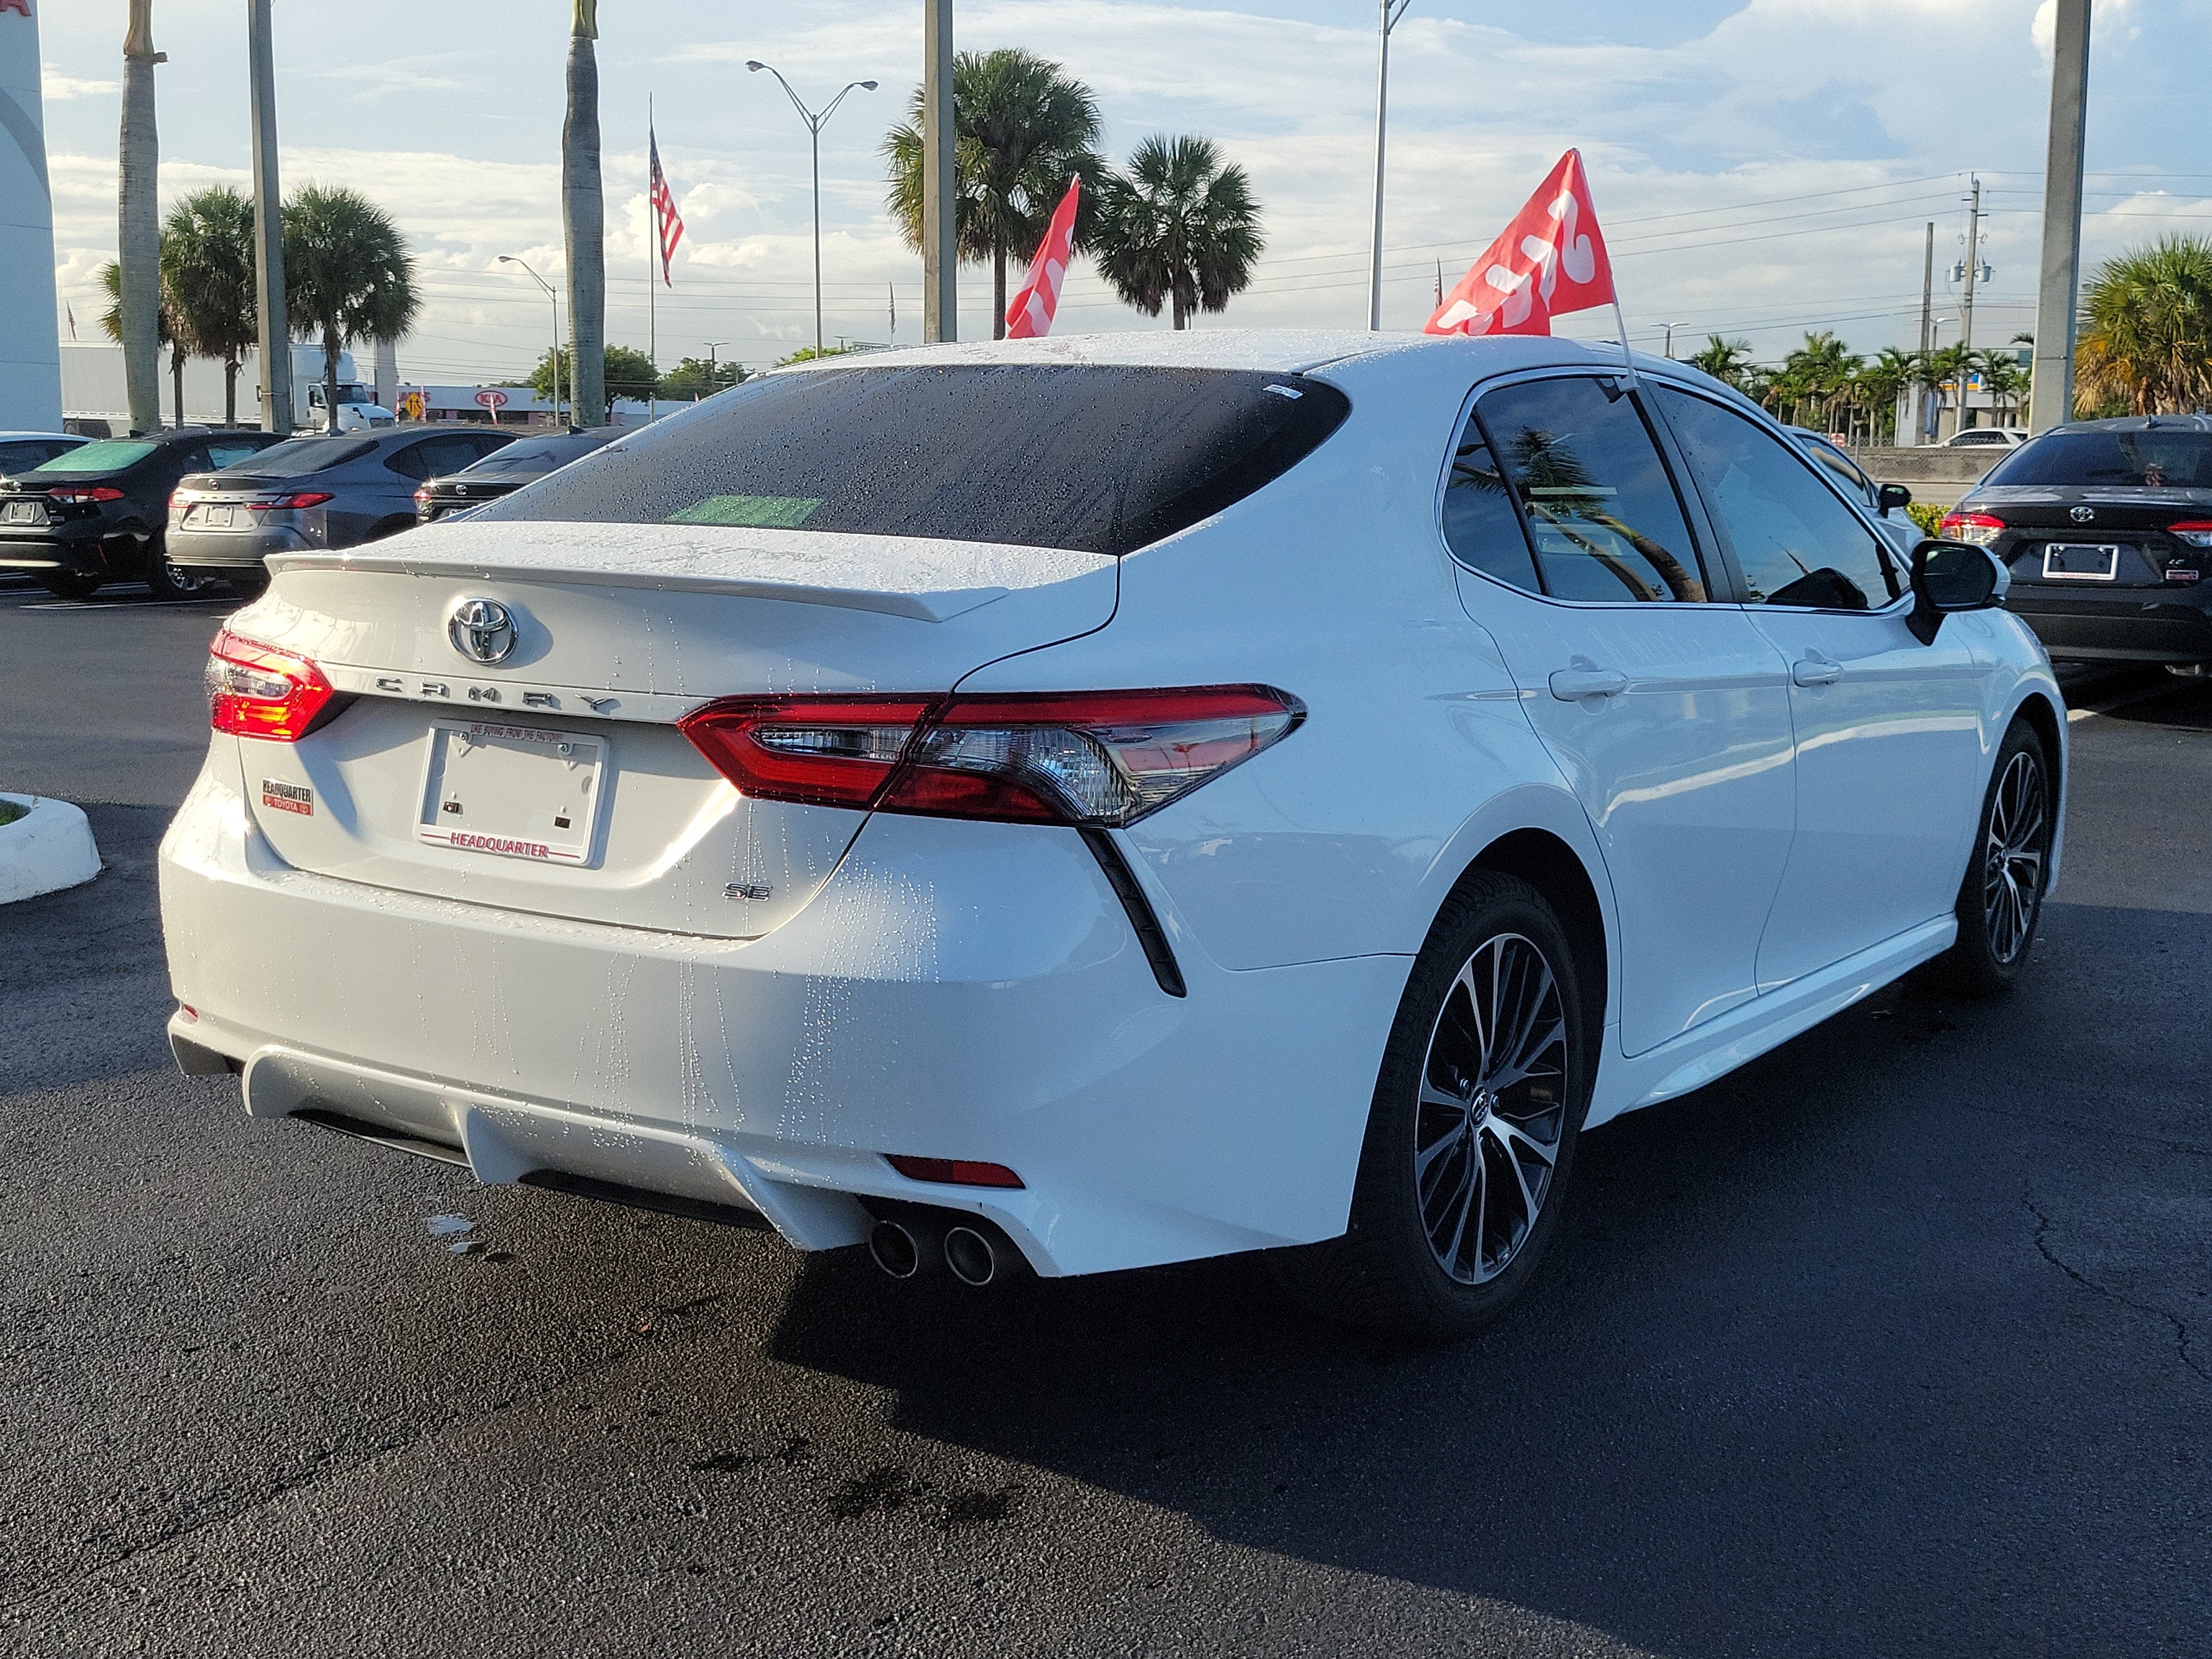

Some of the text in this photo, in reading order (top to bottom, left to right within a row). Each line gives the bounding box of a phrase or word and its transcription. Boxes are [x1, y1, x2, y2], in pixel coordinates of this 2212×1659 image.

[375, 675, 614, 710] CAMRY
[263, 779, 311, 803] HEADQUARTER
[274, 798, 298, 811] TOYOTA
[450, 832, 549, 859] HEADQUARTER
[721, 882, 773, 901] SE
